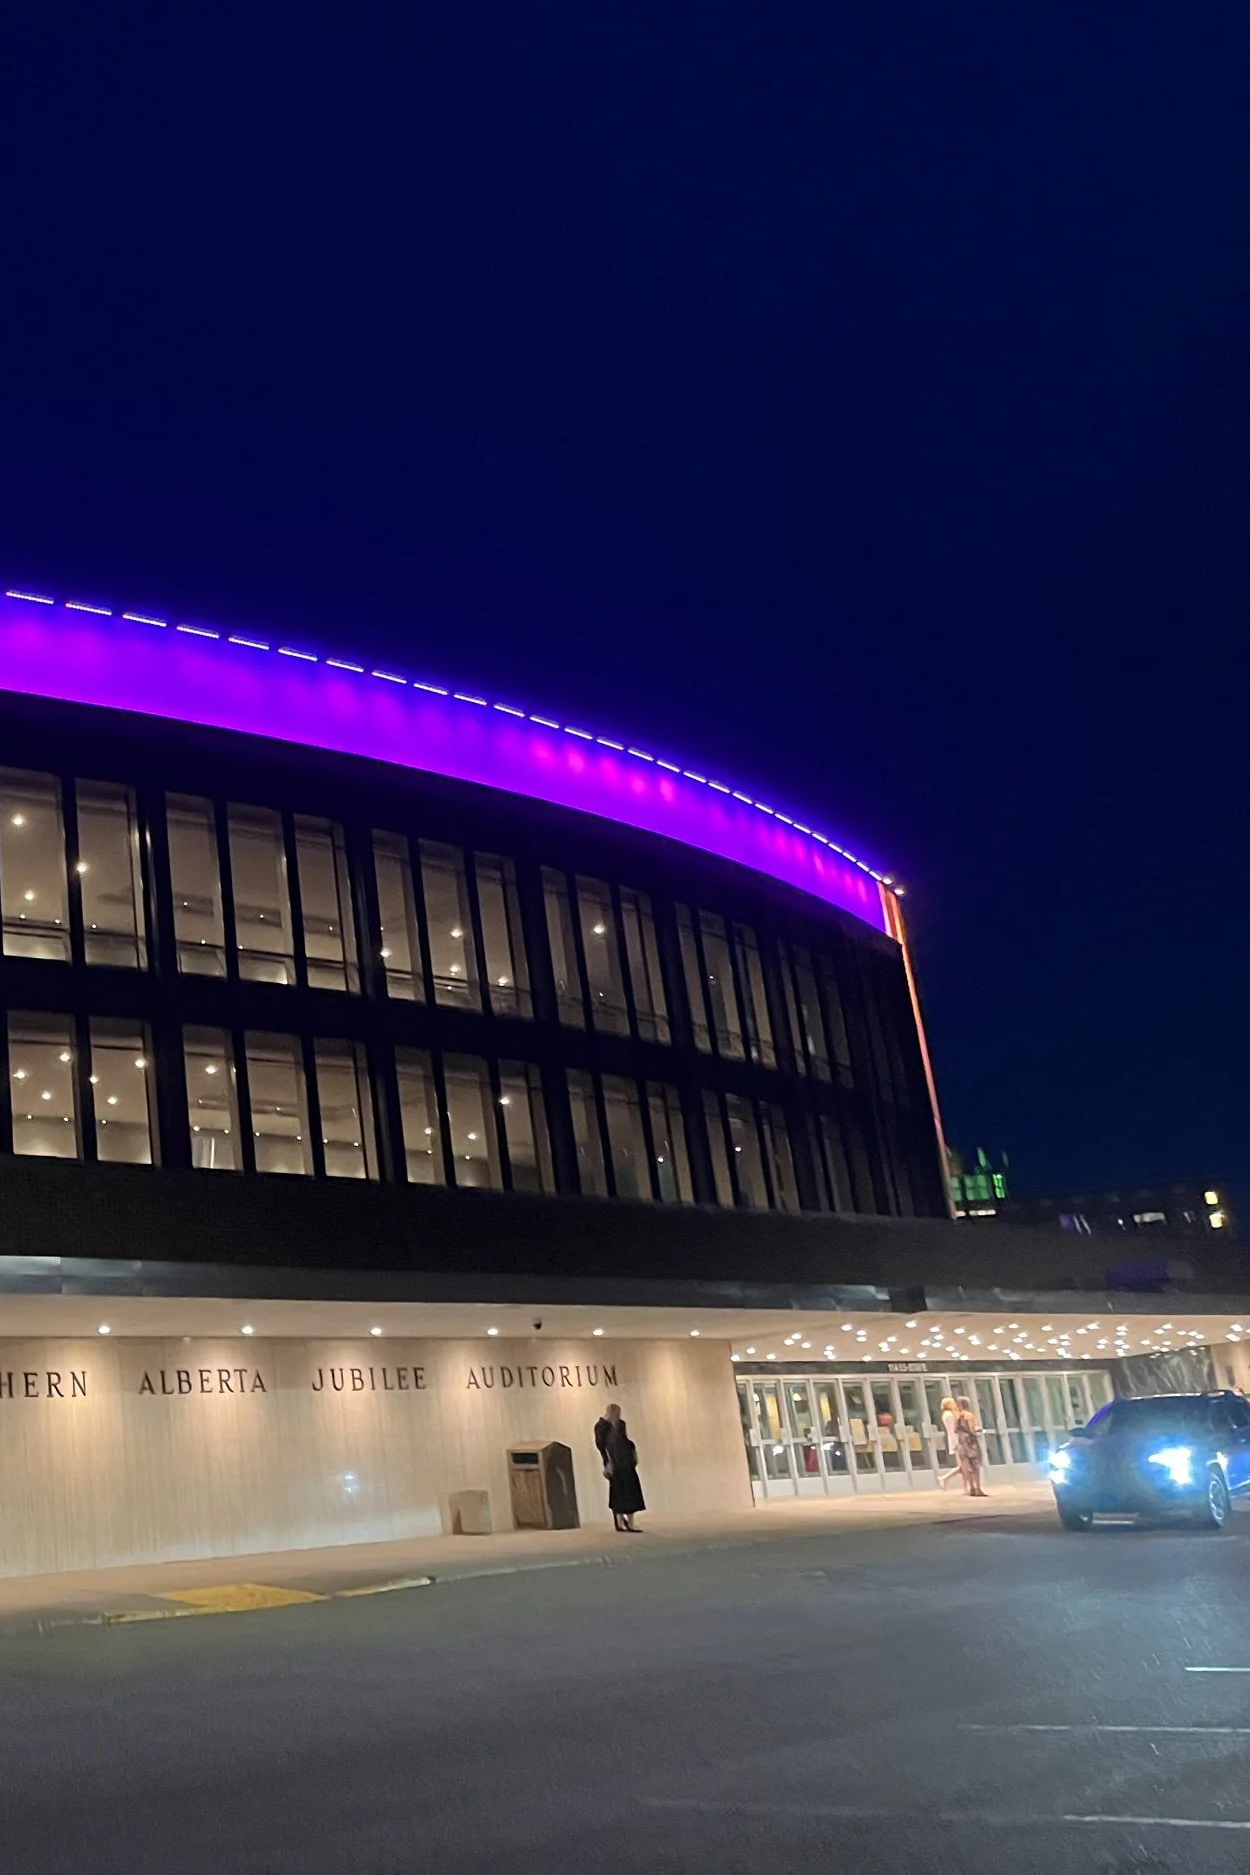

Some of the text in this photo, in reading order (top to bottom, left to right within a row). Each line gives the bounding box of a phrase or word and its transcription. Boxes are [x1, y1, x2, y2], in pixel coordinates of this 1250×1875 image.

[138, 1368, 268, 1396] ALBERTA
[311, 1366, 427, 1392] JUBILEE
[466, 1364, 619, 1390] AUDITORIUM
